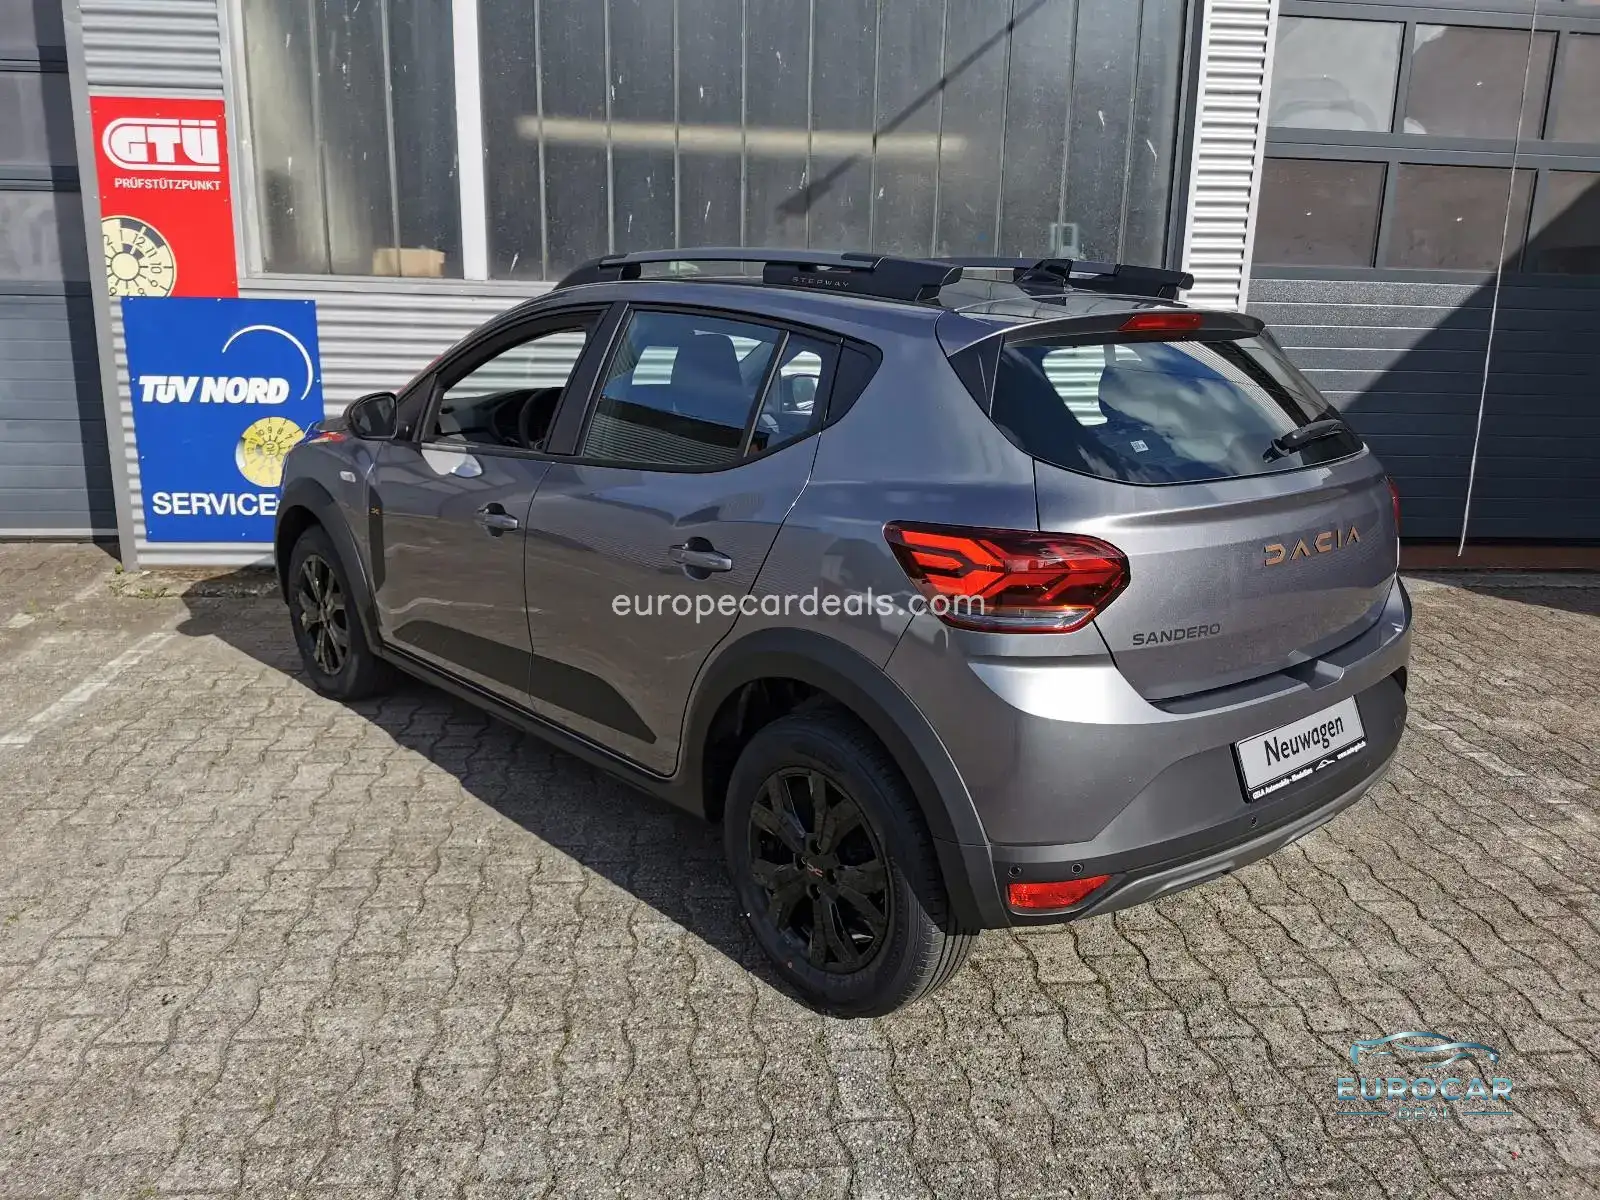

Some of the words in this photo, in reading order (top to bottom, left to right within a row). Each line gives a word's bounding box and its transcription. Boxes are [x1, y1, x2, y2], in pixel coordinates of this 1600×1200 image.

[108, 118, 221, 165] GTÜ
[114, 177, 221, 191] PRÜFSTÜTZPUNKT
[132, 233, 146, 248] 12
[150, 262, 162, 274] 10
[792, 275, 850, 288] STEPWAY
[200, 376, 290, 405] NORD
[152, 492, 278, 516] SERVICE
[1263, 526, 1361, 567] DACIA
[1132, 622, 1221, 646] SANDERO
[1263, 716, 1344, 767] Neuwagen
